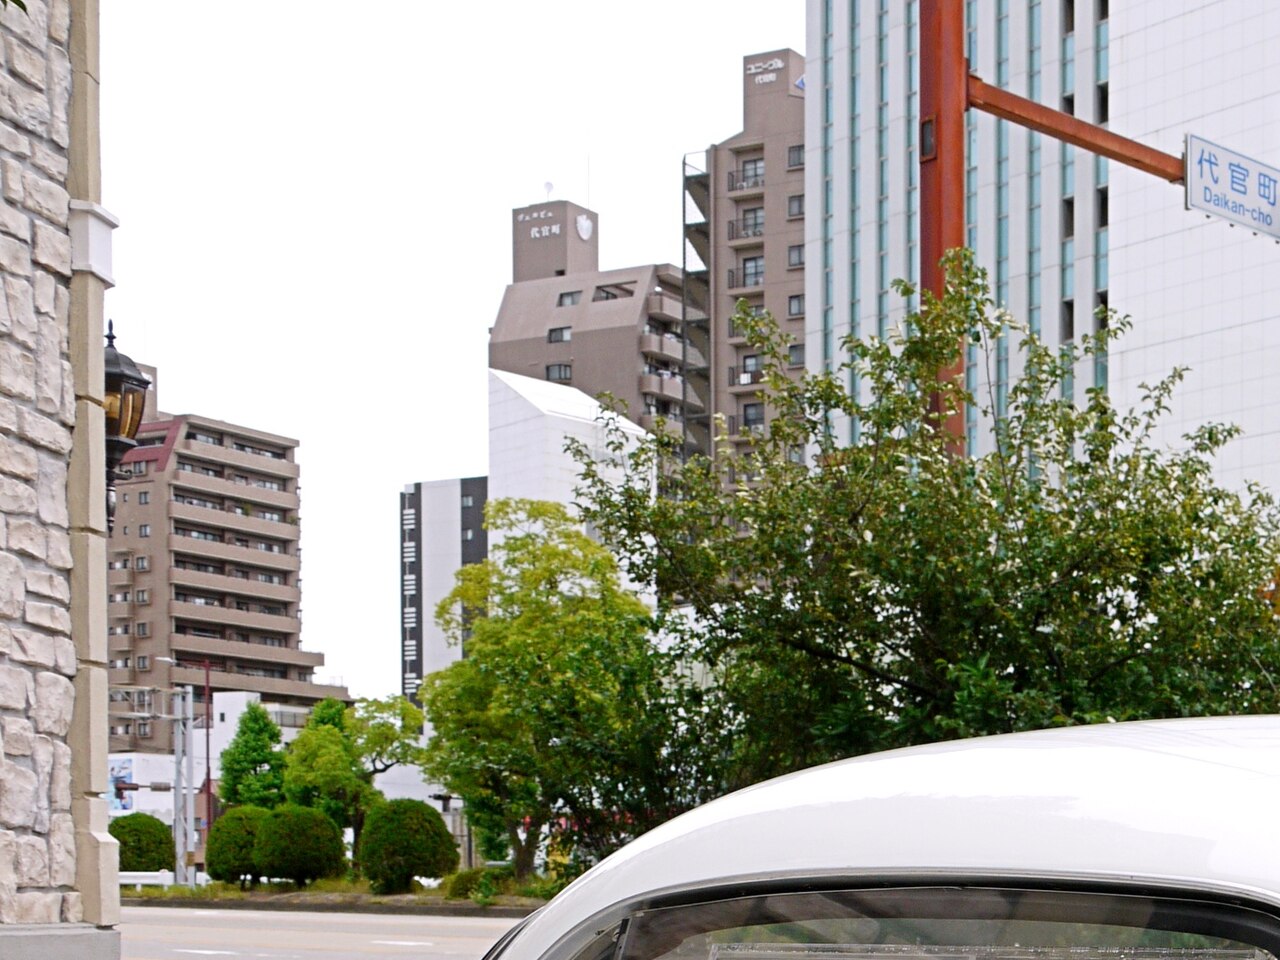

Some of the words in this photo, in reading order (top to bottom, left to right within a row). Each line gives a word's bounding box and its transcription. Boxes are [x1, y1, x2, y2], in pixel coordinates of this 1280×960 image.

[1197, 149, 1278, 206] 代官町
[1203, 185, 1273, 226] Daikan-cho
